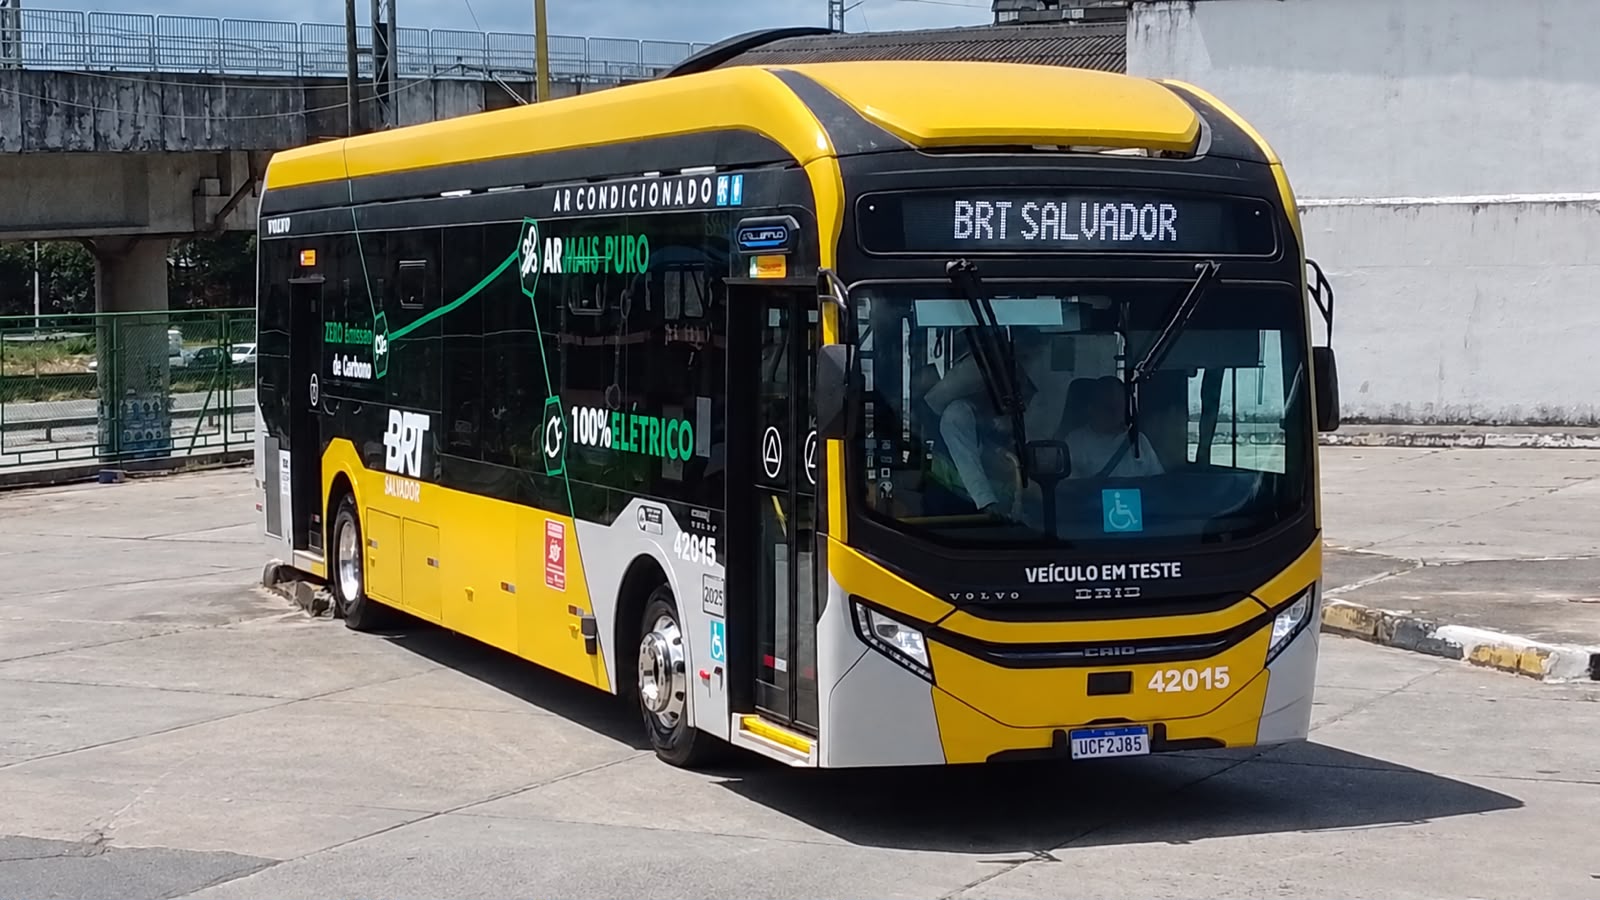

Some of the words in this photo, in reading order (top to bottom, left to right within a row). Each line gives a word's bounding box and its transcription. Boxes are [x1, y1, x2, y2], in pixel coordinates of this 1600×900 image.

[553, 189, 571, 212] AR
[576, 177, 712, 211] CONDICIONADO
[954, 200, 1012, 240] BRT
[1021, 201, 1177, 241] SALVADOR
[543, 237, 563, 273] AR
[562, 235, 599, 274] MAIS
[605, 233, 650, 274] PURO
[324, 321, 343, 343] ZERO
[333, 352, 342, 376] de
[343, 354, 372, 379] Carbono
[383, 408, 430, 478] BRT
[571, 405, 611, 448] 100%
[611, 402, 694, 461] ELÉTRICO
[385, 475, 421, 503] SALVADOR
[673, 530, 717, 567] 42015
[1025, 563, 1098, 583] VEÍCULO
[1101, 564, 1127, 580] EM
[1129, 562, 1182, 579] TESTE
[704, 586, 723, 607] 2025
[949, 591, 1020, 600] VOLVO
[1147, 666, 1231, 693] 42015
[1079, 736, 1142, 756] UCF2J85
